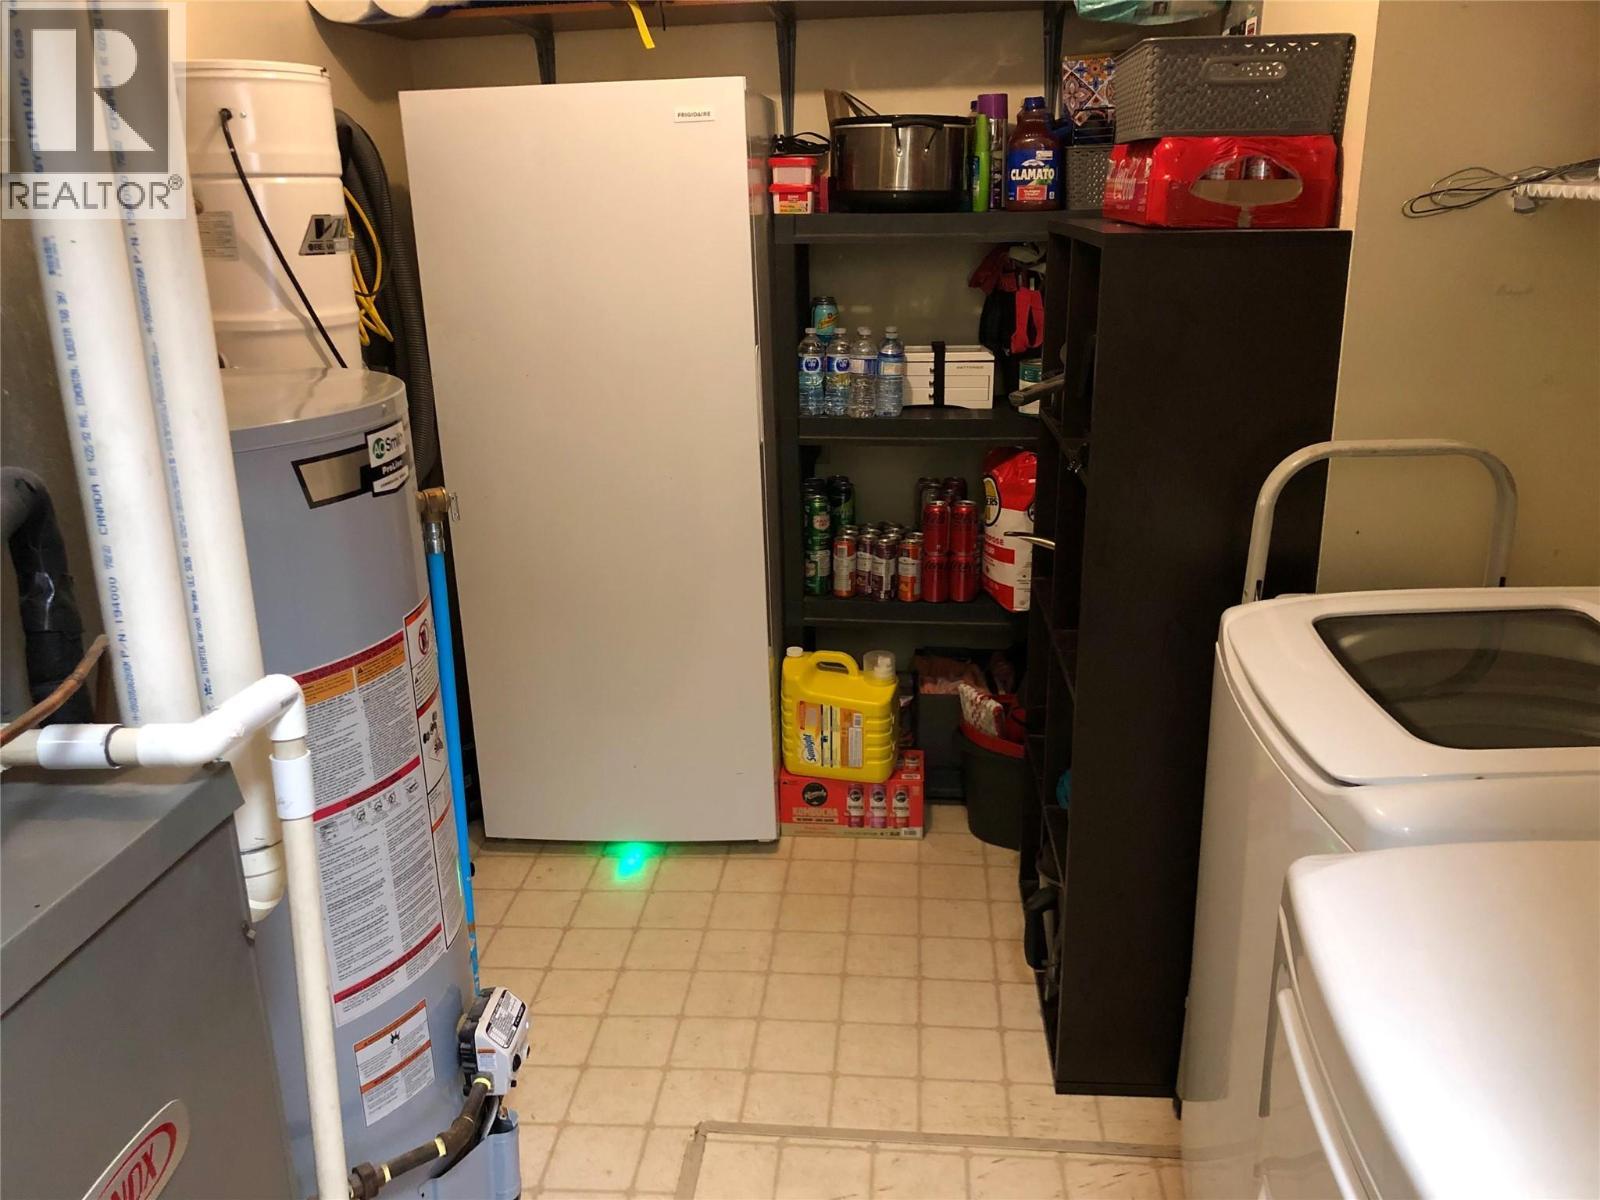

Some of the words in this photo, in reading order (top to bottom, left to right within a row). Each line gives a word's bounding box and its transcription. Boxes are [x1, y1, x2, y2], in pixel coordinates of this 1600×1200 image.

[677, 111, 711, 119] FRIGIDAIRE
[1010, 168, 1055, 181] CLAMATO
[91, 483, 108, 536] CANADA
[803, 734, 817, 762] Sunlight
